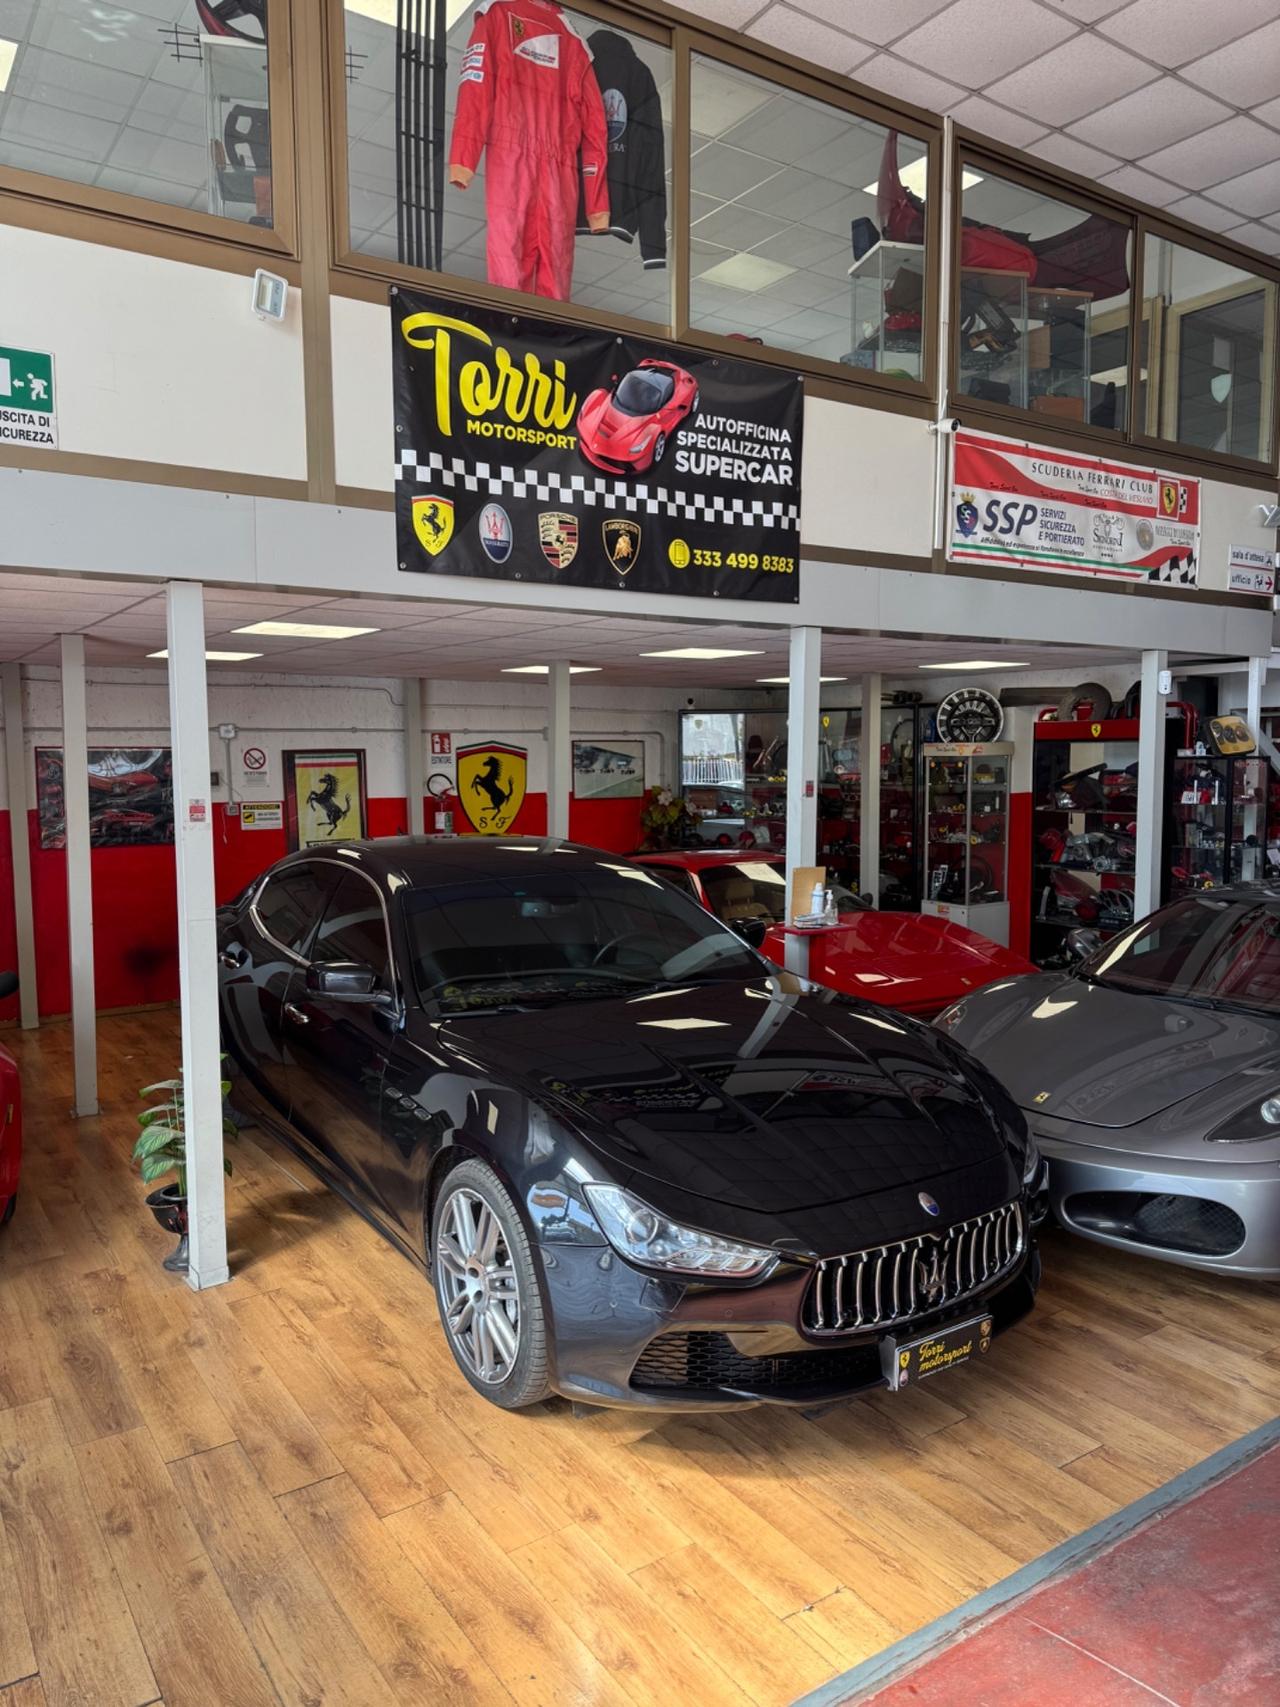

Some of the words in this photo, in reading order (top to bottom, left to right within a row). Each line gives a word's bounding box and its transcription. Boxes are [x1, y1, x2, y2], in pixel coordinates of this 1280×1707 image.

[401, 312, 577, 436] Torri
[0, 427, 54, 444] ICUREZZA
[38, 416, 50, 428] DI
[467, 419, 577, 450] MOTORSPORT
[695, 413, 792, 443] AUTOFFICINA
[676, 431, 793, 461] SPECIALIZZATA
[675, 450, 793, 486] SUPERCAR
[1032, 462, 1084, 481] SCUDERIA
[1087, 472, 1126, 490] FERRARI
[1129, 480, 1153, 494] CLUB
[983, 499, 1038, 536] SSP
[1039, 519, 1076, 534] SICUREZZA
[1040, 507, 1066, 519] SERVIZI
[1038, 531, 1043, 541] E
[1044, 532, 1085, 547] PORTIERATO
[693, 550, 722, 567] 333
[726, 553, 759, 570] 499
[762, 555, 794, 573] 8383
